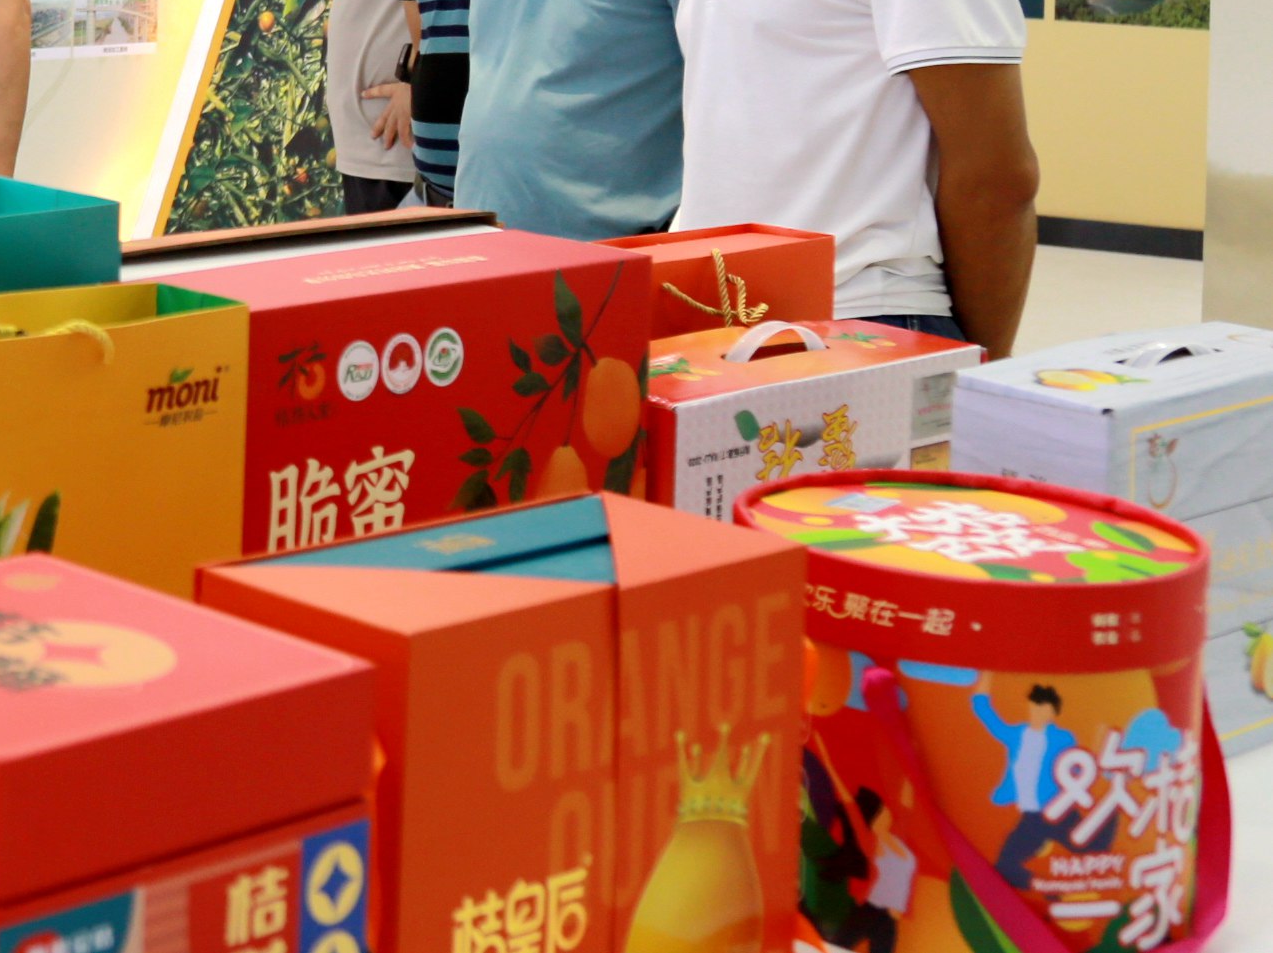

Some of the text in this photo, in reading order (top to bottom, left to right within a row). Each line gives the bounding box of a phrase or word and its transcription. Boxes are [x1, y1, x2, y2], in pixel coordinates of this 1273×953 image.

[146, 365, 220, 413] moni
[268, 445, 416, 553] 脆蜜
[495, 591, 791, 793] ORANGE
[1049, 853, 1125, 877] HAPPY
[224, 865, 289, 953] 桔
[452, 866, 588, 953] 桔皇后
